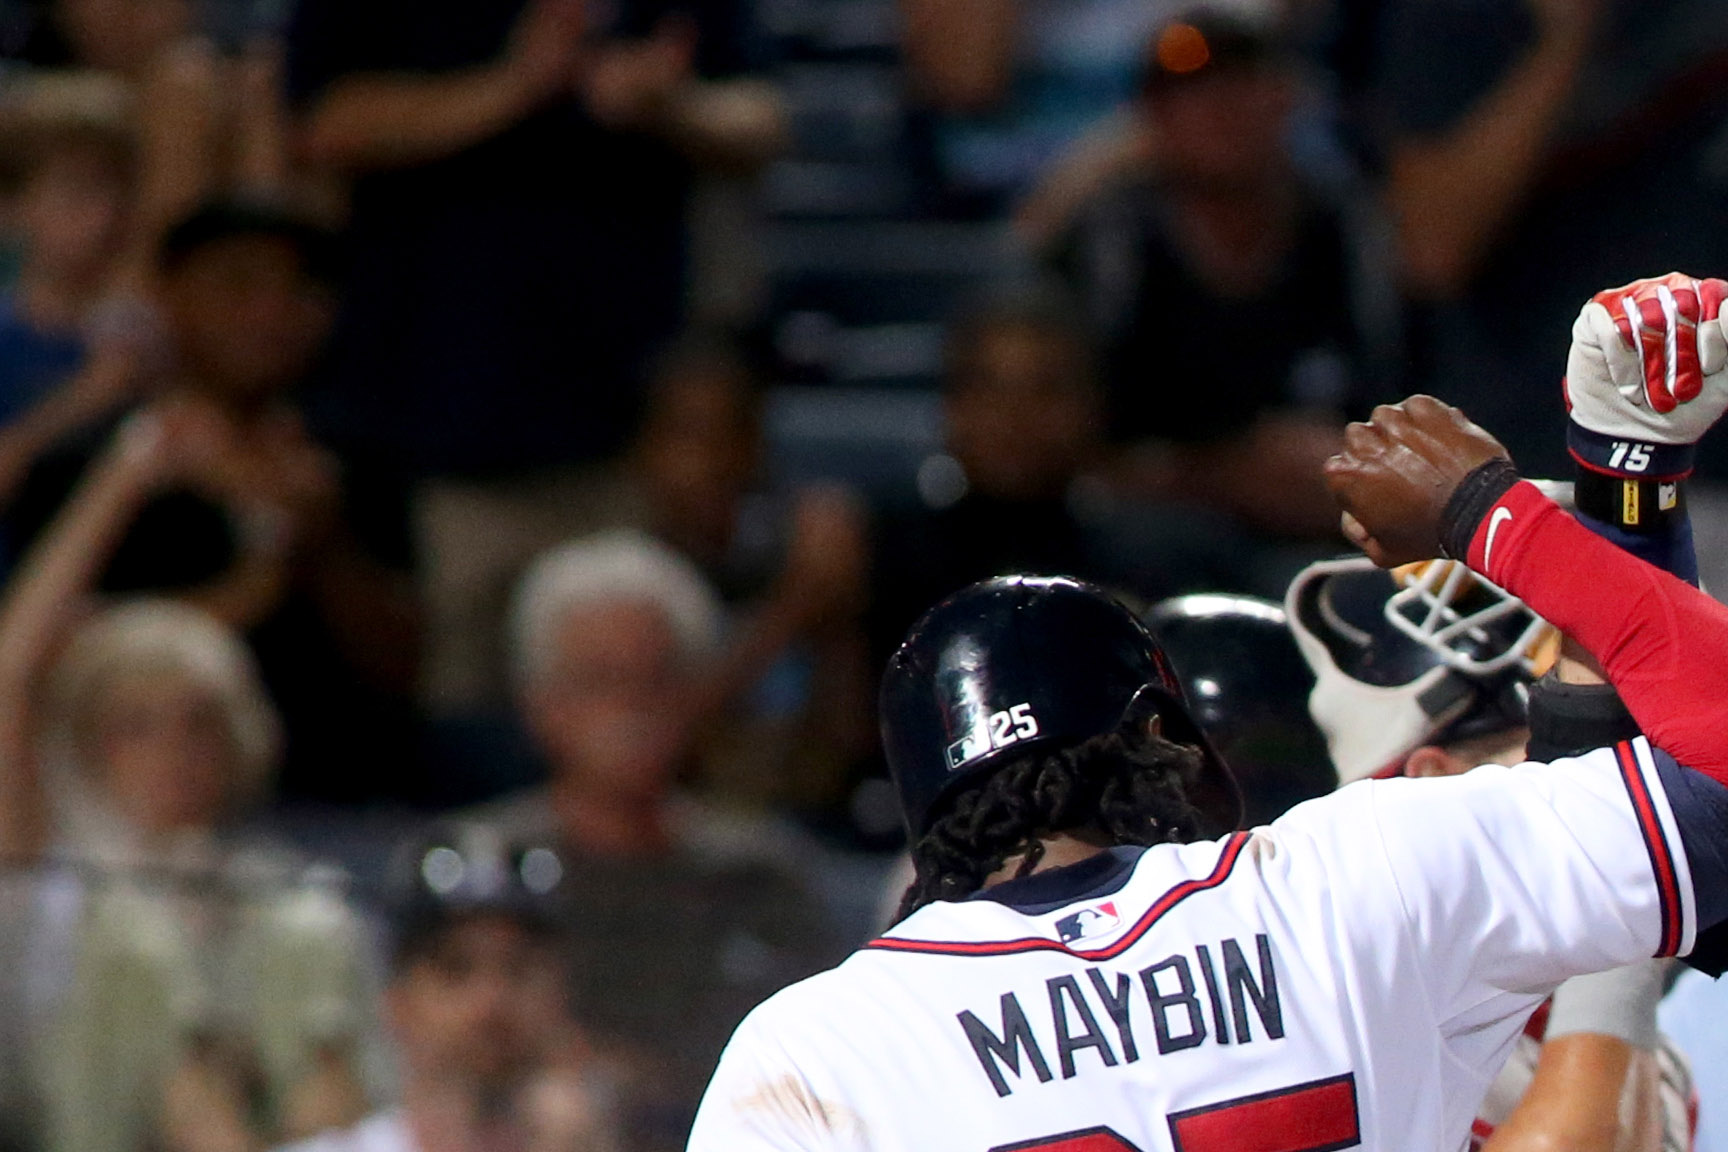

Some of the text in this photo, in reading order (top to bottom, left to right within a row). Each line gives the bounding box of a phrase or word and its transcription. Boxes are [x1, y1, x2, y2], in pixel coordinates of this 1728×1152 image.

[1609, 441, 1655, 472] 15
[991, 702, 1039, 748] 25
[956, 934, 1285, 1098] MAYBIN
